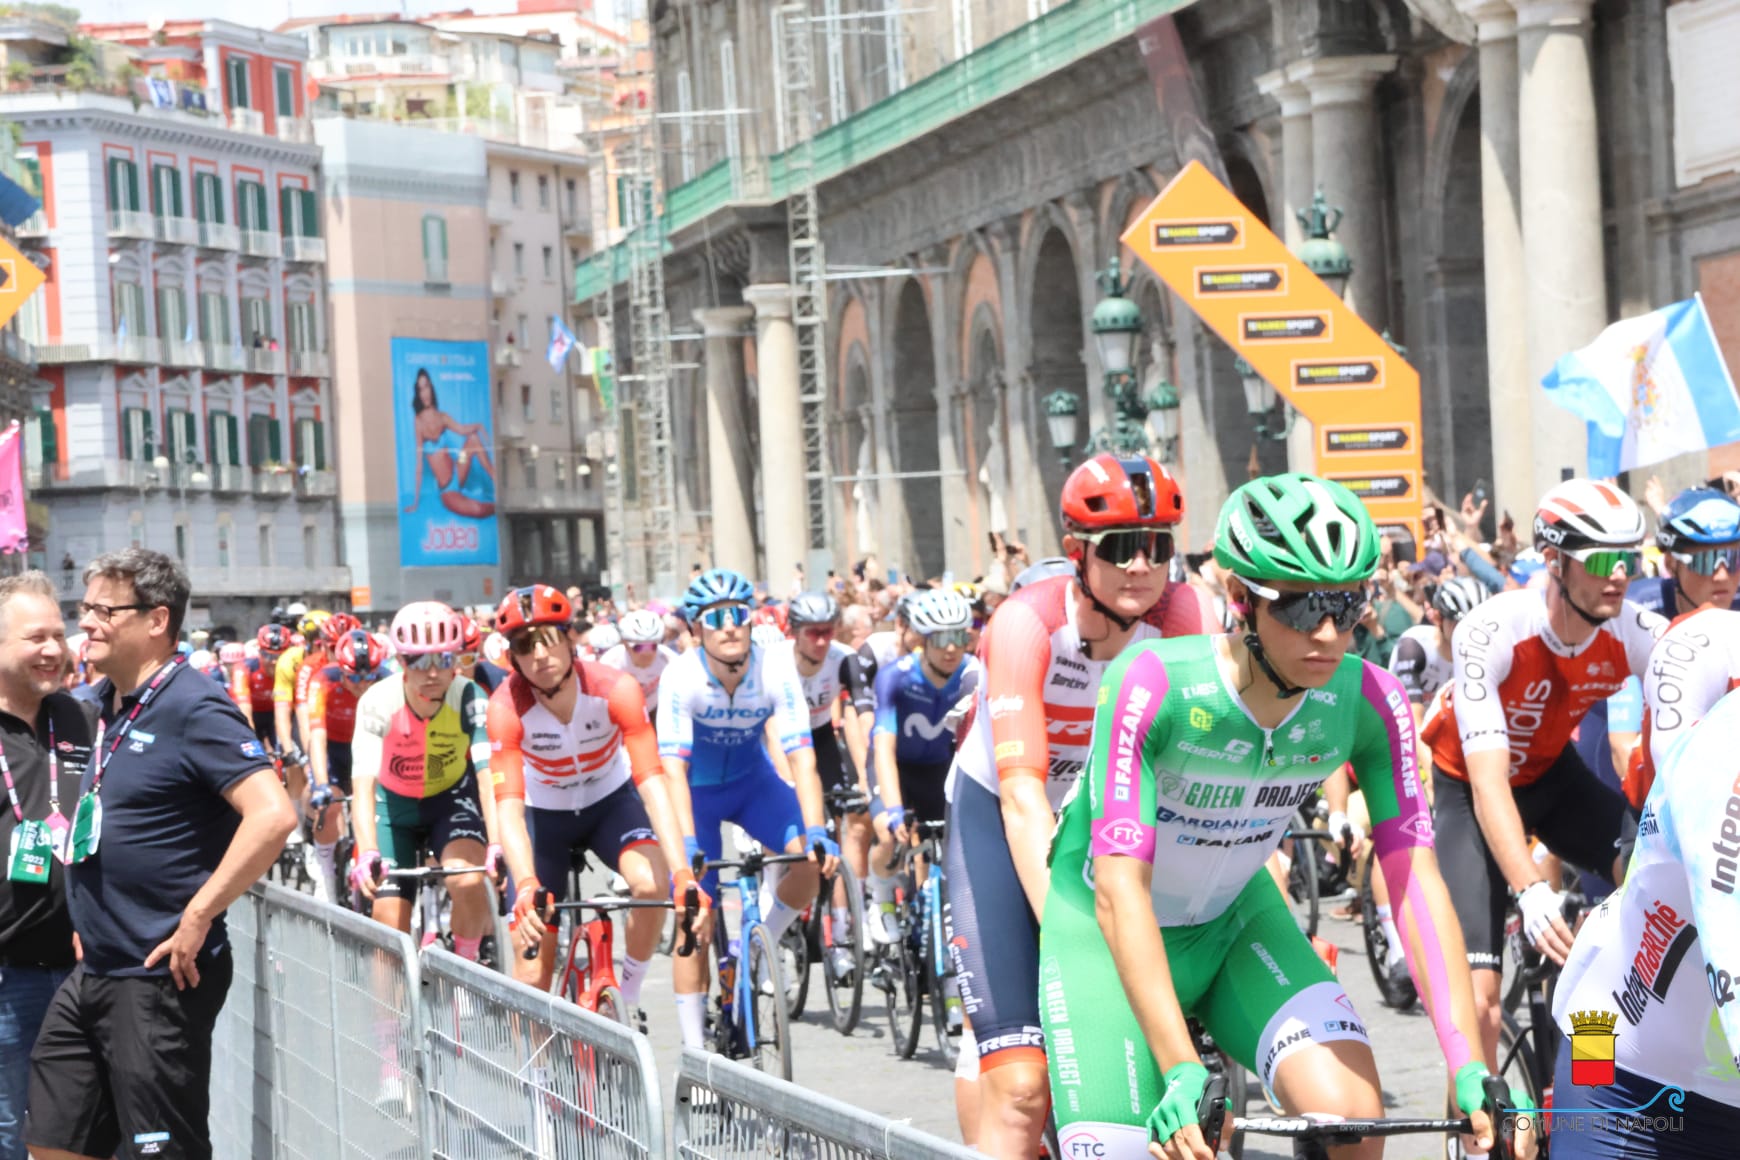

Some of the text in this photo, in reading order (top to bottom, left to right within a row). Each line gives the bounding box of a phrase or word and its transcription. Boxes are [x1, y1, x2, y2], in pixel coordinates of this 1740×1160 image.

[1115, 684, 1152, 785] FAIZANE
[1392, 702, 1418, 799] FAIZANE
[1184, 782, 1247, 809] GREEN
[1113, 826, 1144, 844] FTC
[1072, 1142, 1106, 1158] FTC
